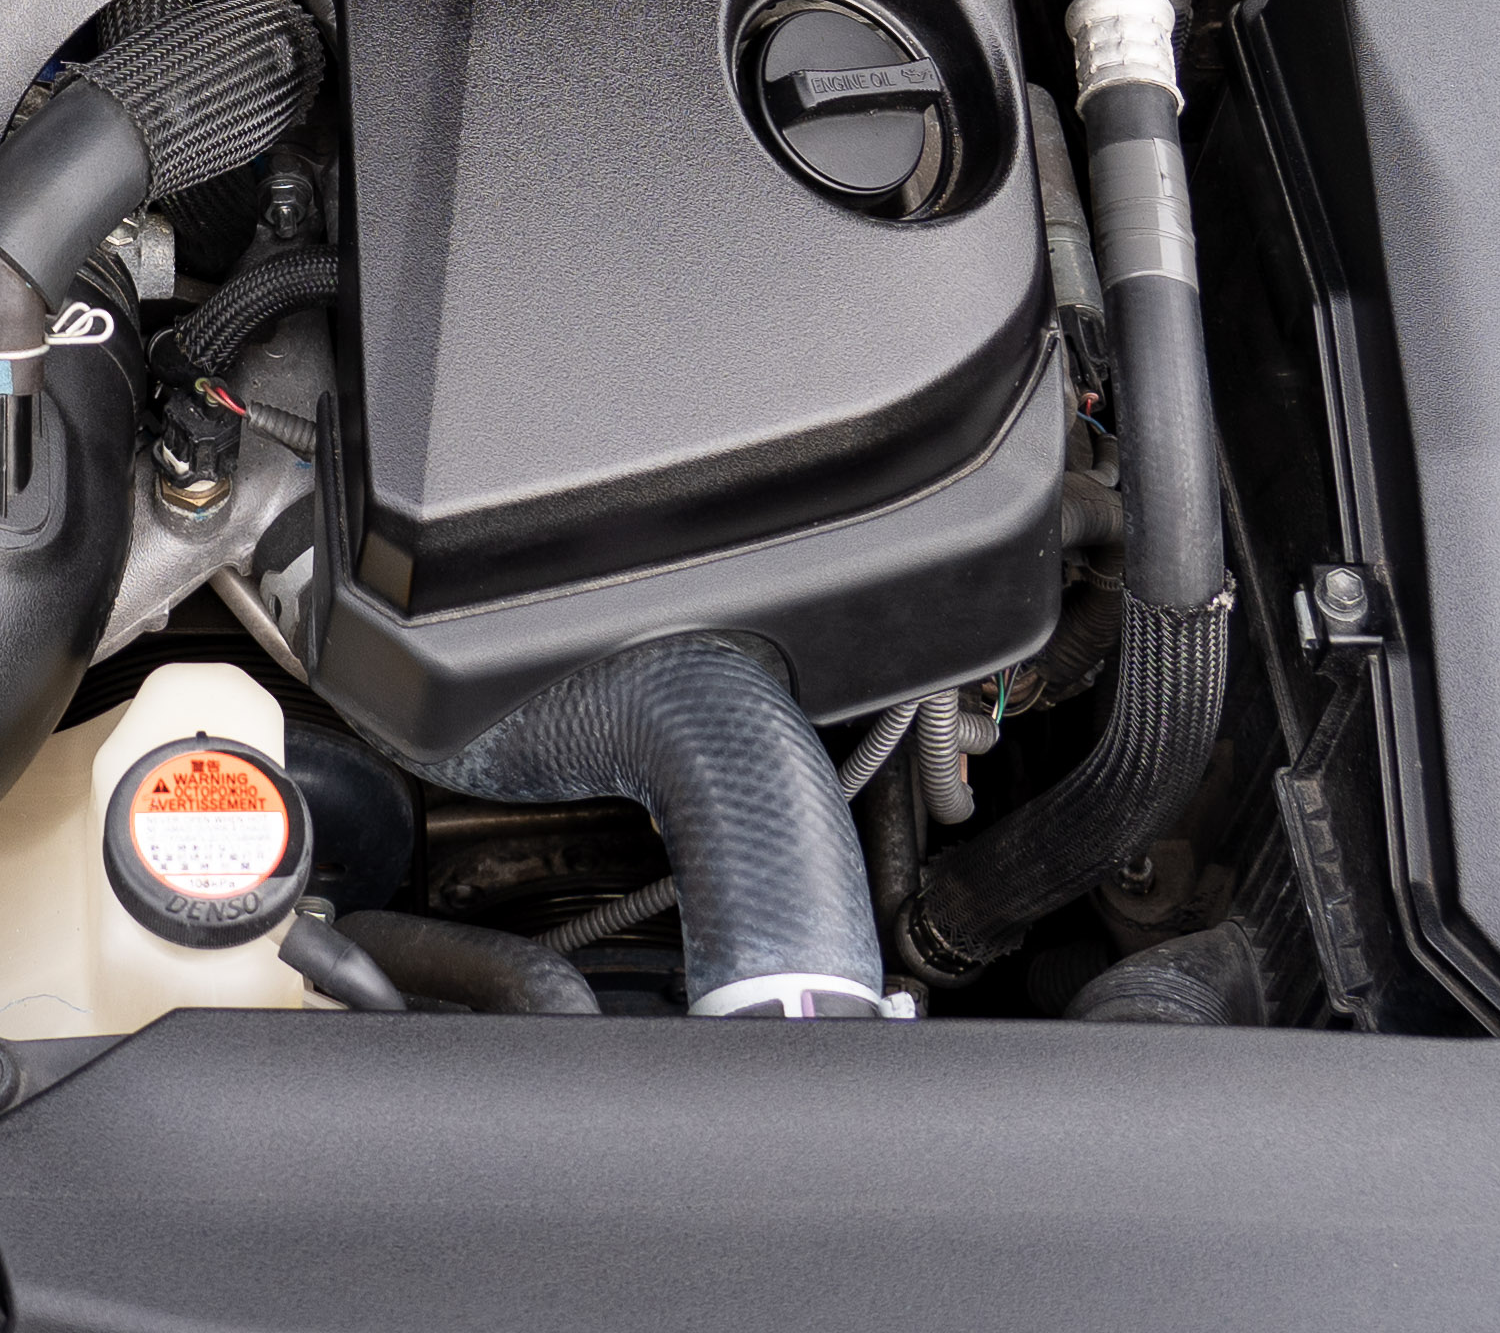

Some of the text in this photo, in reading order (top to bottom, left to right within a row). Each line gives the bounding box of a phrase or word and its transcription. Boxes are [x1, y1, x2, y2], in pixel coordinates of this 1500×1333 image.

[811, 71, 897, 94] ENGINE OIL
[173, 772, 249, 786] WARNING
[174, 785, 258, 798] ОСТОРОЖНО
[150, 797, 267, 811] AVERTISSEMENT
[165, 891, 260, 922] DENSO
